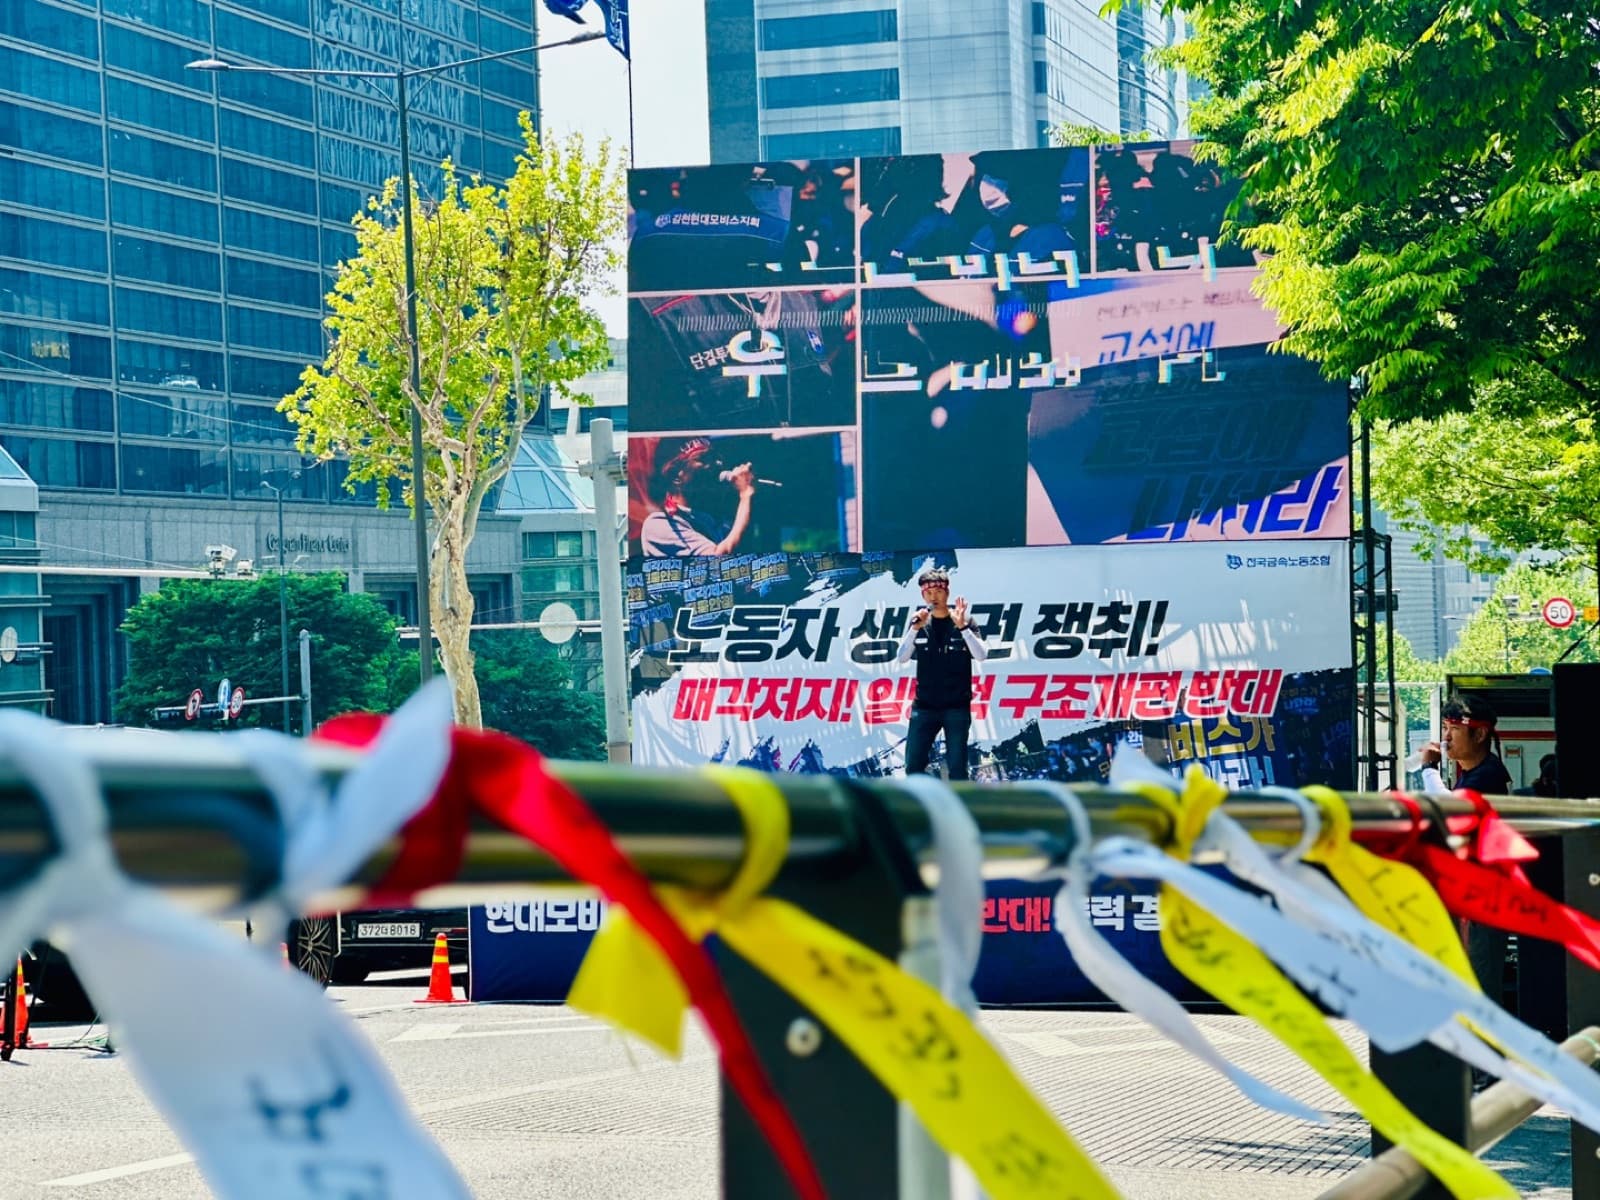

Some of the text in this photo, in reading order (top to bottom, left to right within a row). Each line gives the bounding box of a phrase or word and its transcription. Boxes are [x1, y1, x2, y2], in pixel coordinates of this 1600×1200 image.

[690, 345, 730, 370] 단결투
[667, 605, 840, 665] 노동자
[849, 602, 1023, 664] 생권
[1031, 600, 1169, 660] 쟁취!
[1550, 605, 1569, 620] 50
[672, 677, 859, 723] 매각저지!
[864, 674, 996, 725] 일적
[998, 671, 1183, 721] 구조개편
[1184, 668, 1284, 718] 반대
